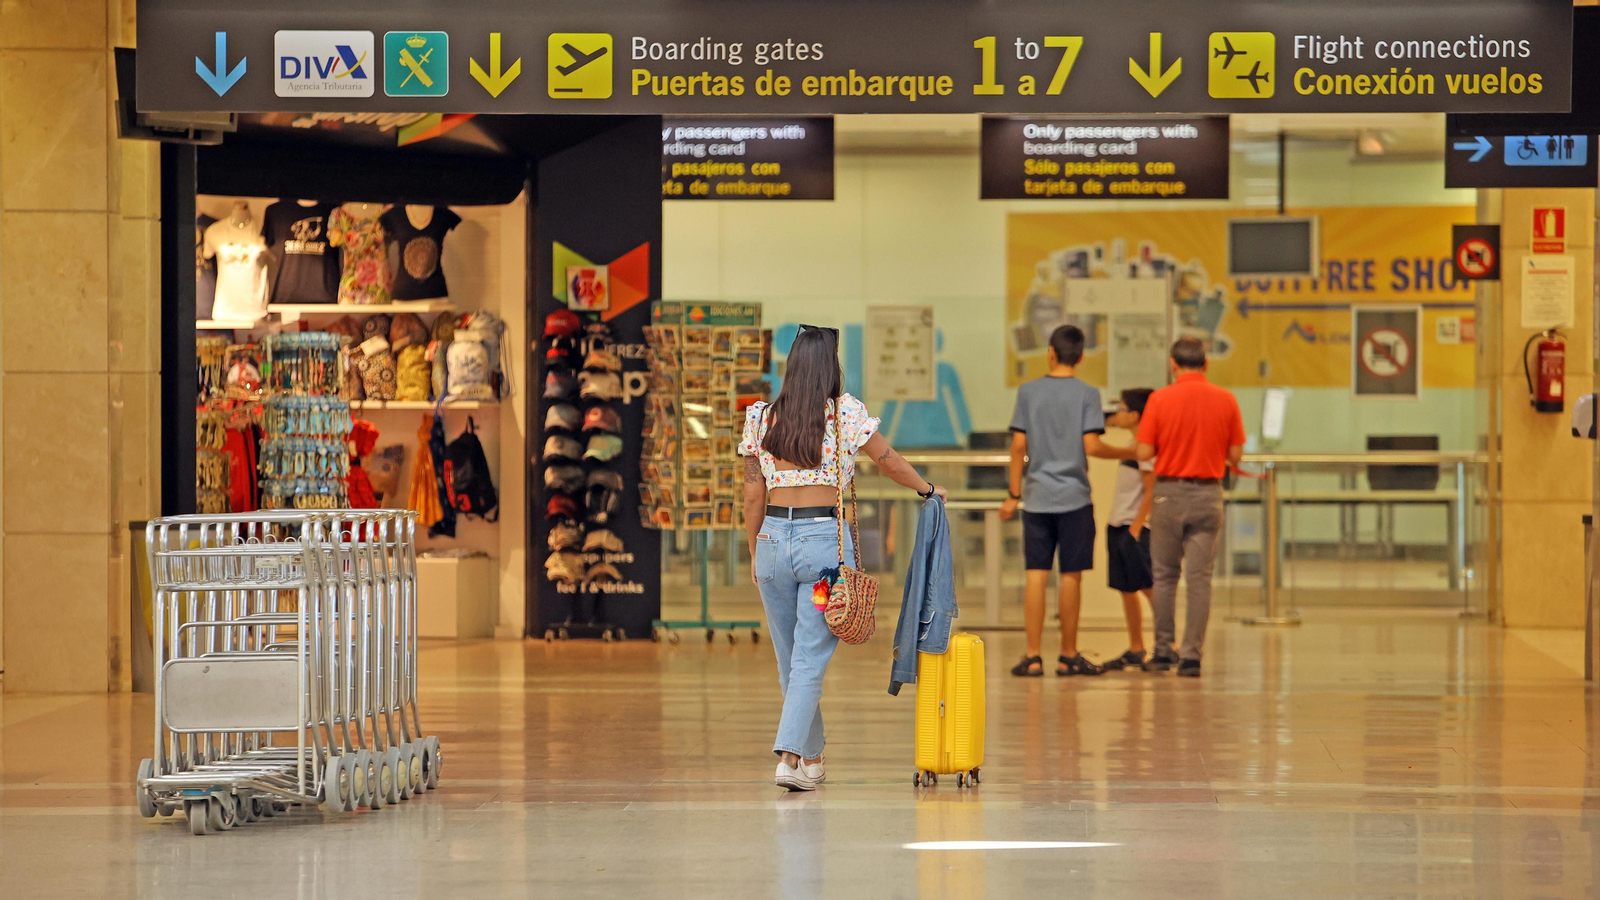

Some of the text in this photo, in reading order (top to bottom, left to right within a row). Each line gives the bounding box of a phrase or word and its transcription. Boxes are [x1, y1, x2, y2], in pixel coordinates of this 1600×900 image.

[632, 36, 825, 65] Boarding gates
[1293, 34, 1531, 64] Flight connections
[280, 45, 368, 79] DIVA
[973, 36, 1084, 95] 1 to 7
[287, 82, 362, 92] Agencia Tributaria
[631, 69, 954, 101] Puertas de embarque
[1017, 74, 1036, 95] a
[1293, 66, 1544, 96] Conexión vuelos
[674, 127, 768, 141] passengers
[769, 125, 806, 140] with
[1023, 124, 1198, 141] Only passengers with
[662, 141, 746, 158] rding card
[1023, 140, 1138, 157] boarding card
[672, 159, 746, 178] pasajeros
[751, 162, 781, 176] con
[1024, 158, 1176, 178] Sólo pasajeros con
[689, 179, 710, 195] de
[716, 179, 792, 198] embarque
[1024, 178, 1187, 197] tarjeta de embarque
[1313, 258, 1376, 292] REE
